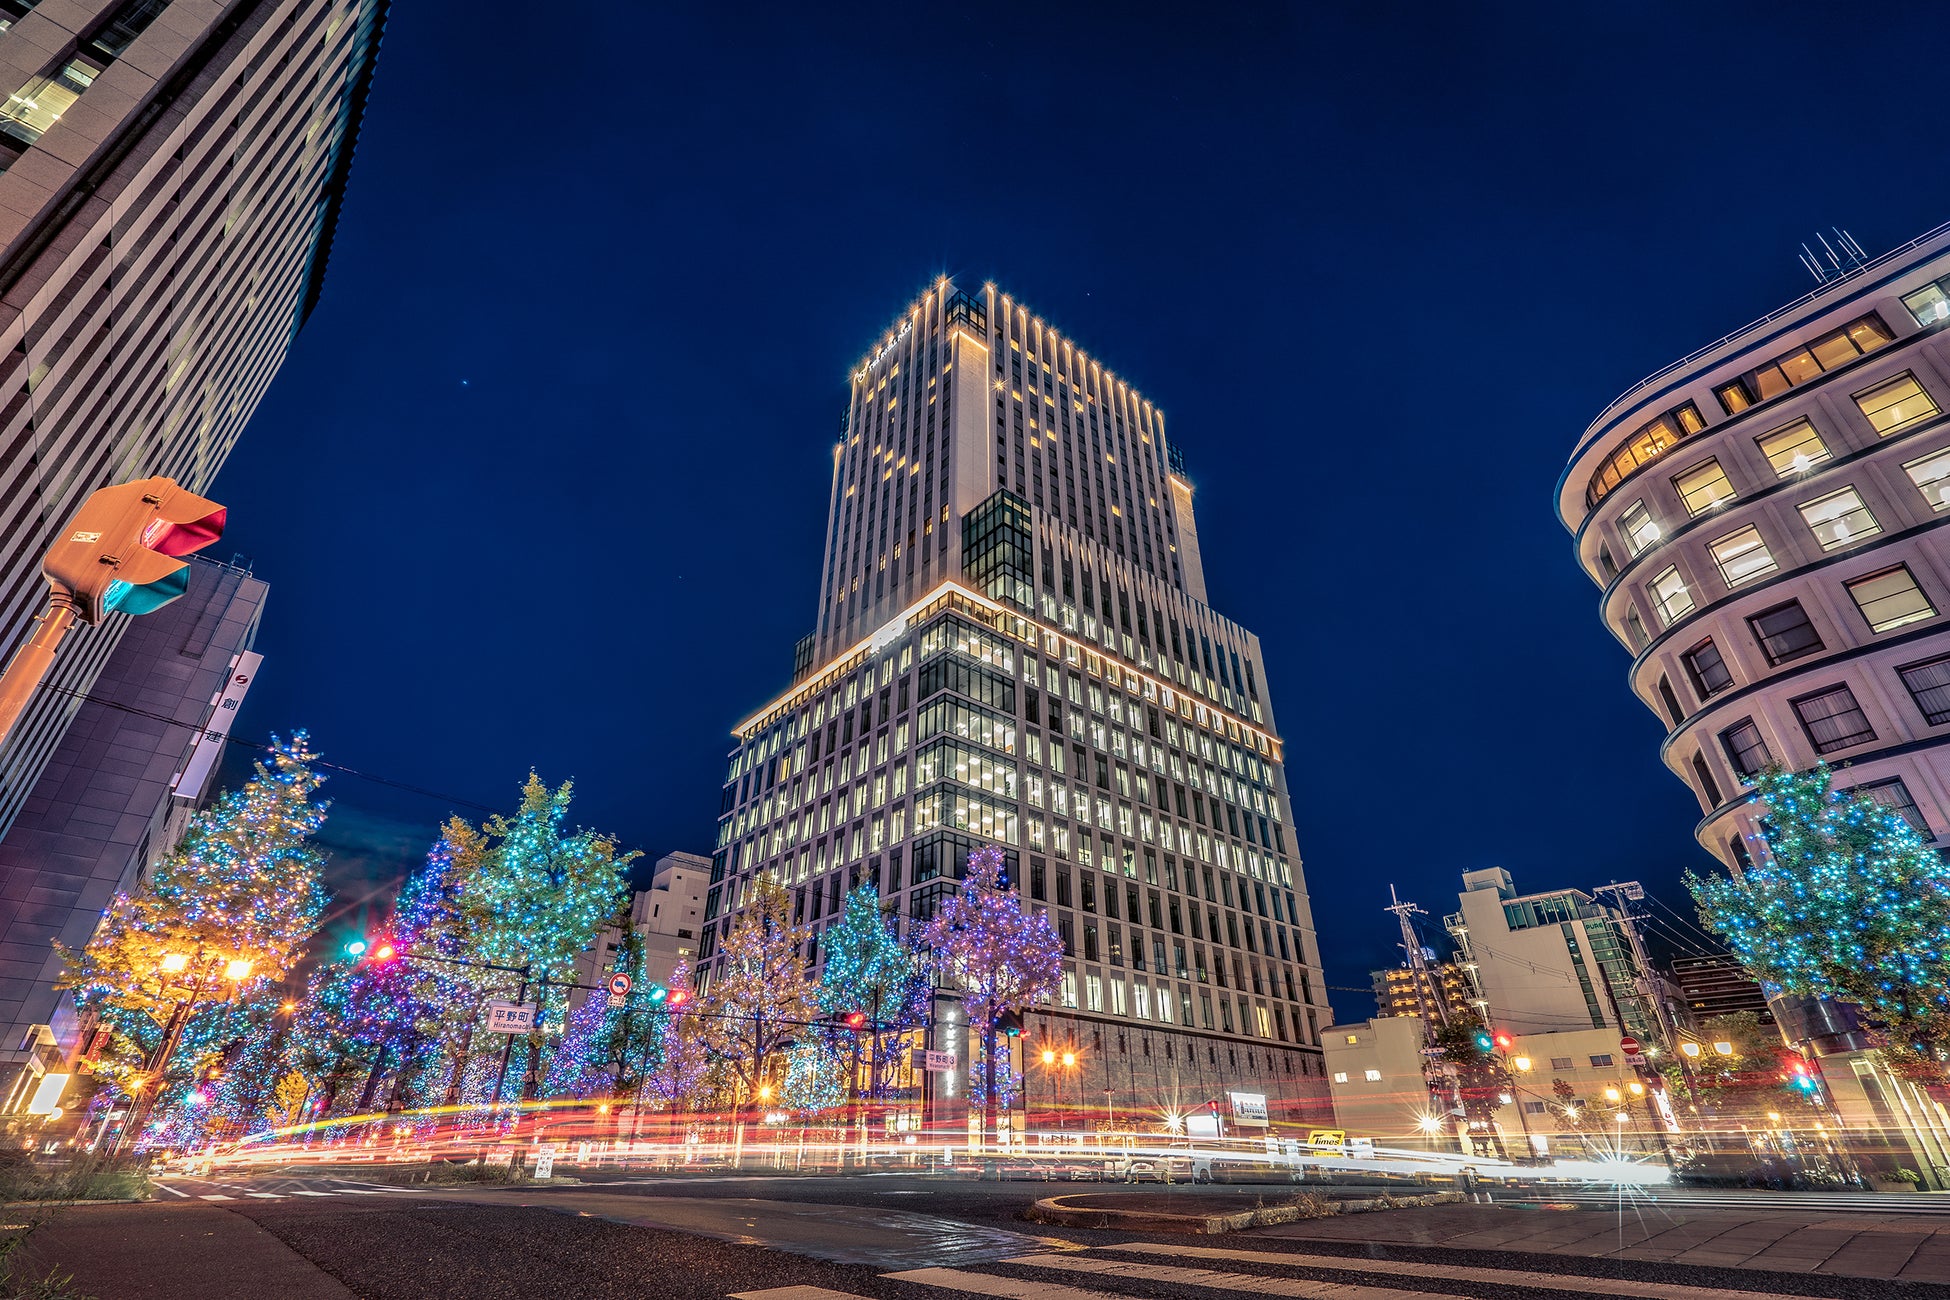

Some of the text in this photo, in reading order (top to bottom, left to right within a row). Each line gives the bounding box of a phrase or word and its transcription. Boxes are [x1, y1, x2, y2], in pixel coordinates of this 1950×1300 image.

[494, 1009, 530, 1023] 平野町
[1311, 1133, 1342, 1146] Times
